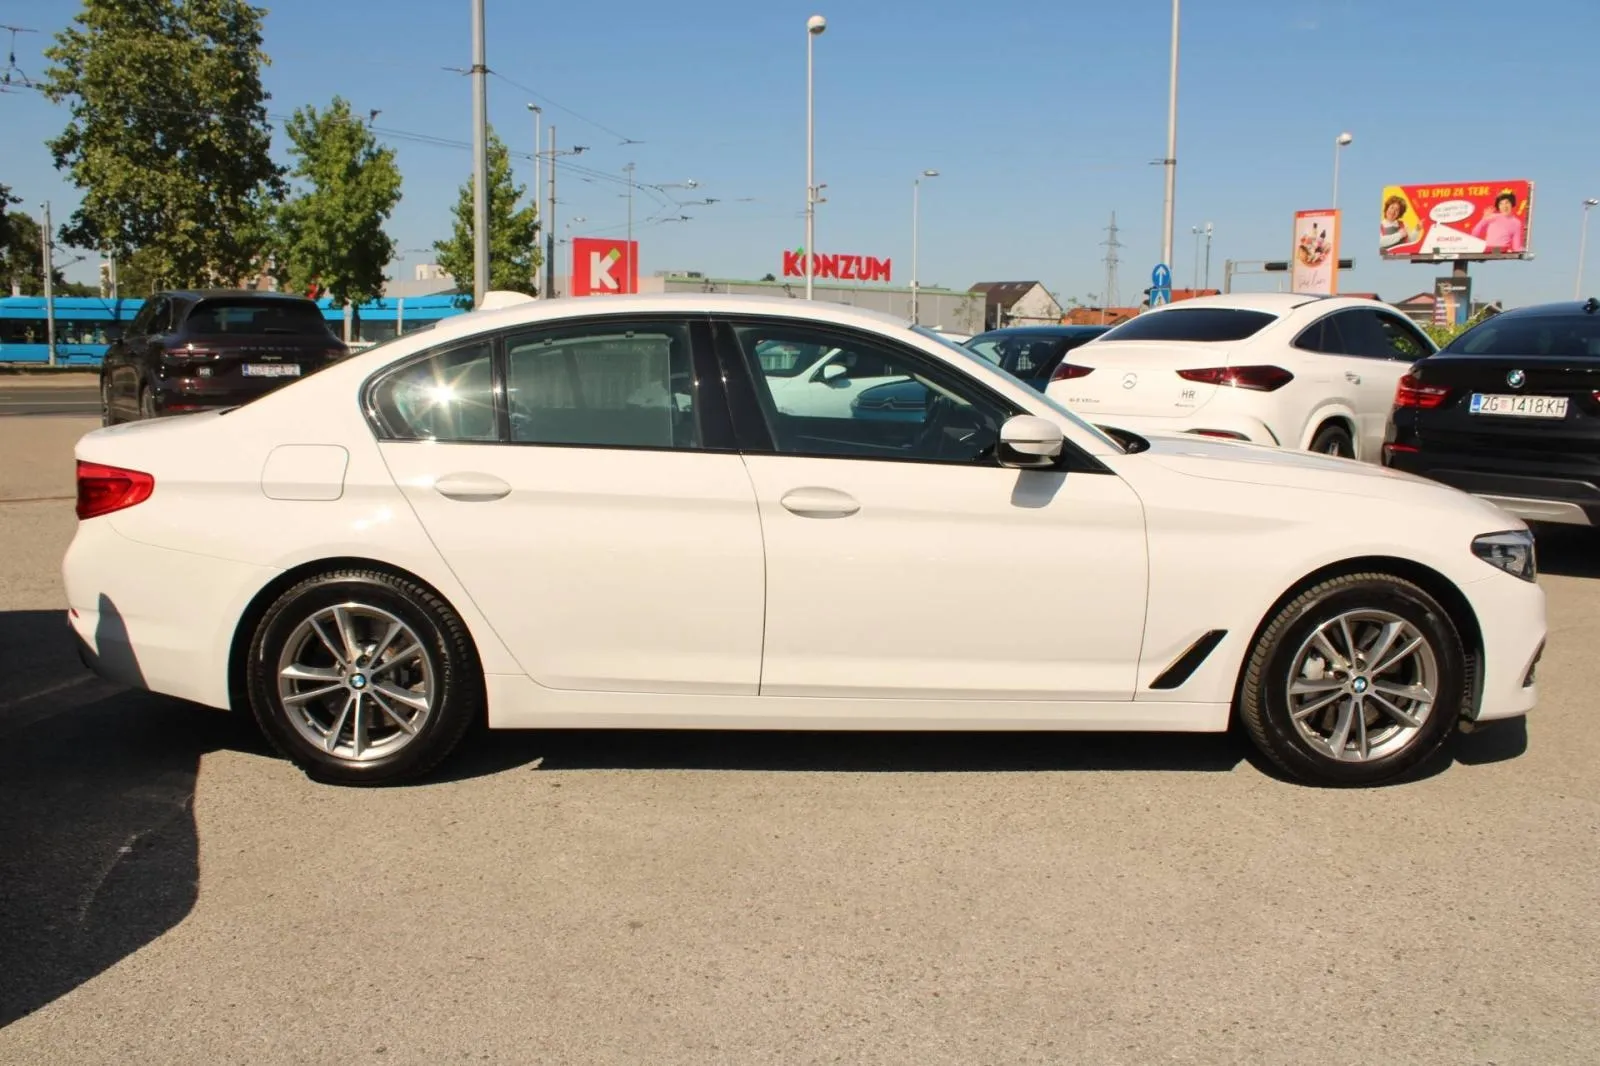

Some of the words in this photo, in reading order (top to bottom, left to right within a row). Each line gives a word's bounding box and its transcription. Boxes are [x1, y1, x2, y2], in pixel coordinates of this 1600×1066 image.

[590, 248, 621, 289] K
[783, 248, 891, 282] KONZUM
[1181, 389, 1196, 399] HR
[1481, 396, 1498, 411] ZG
